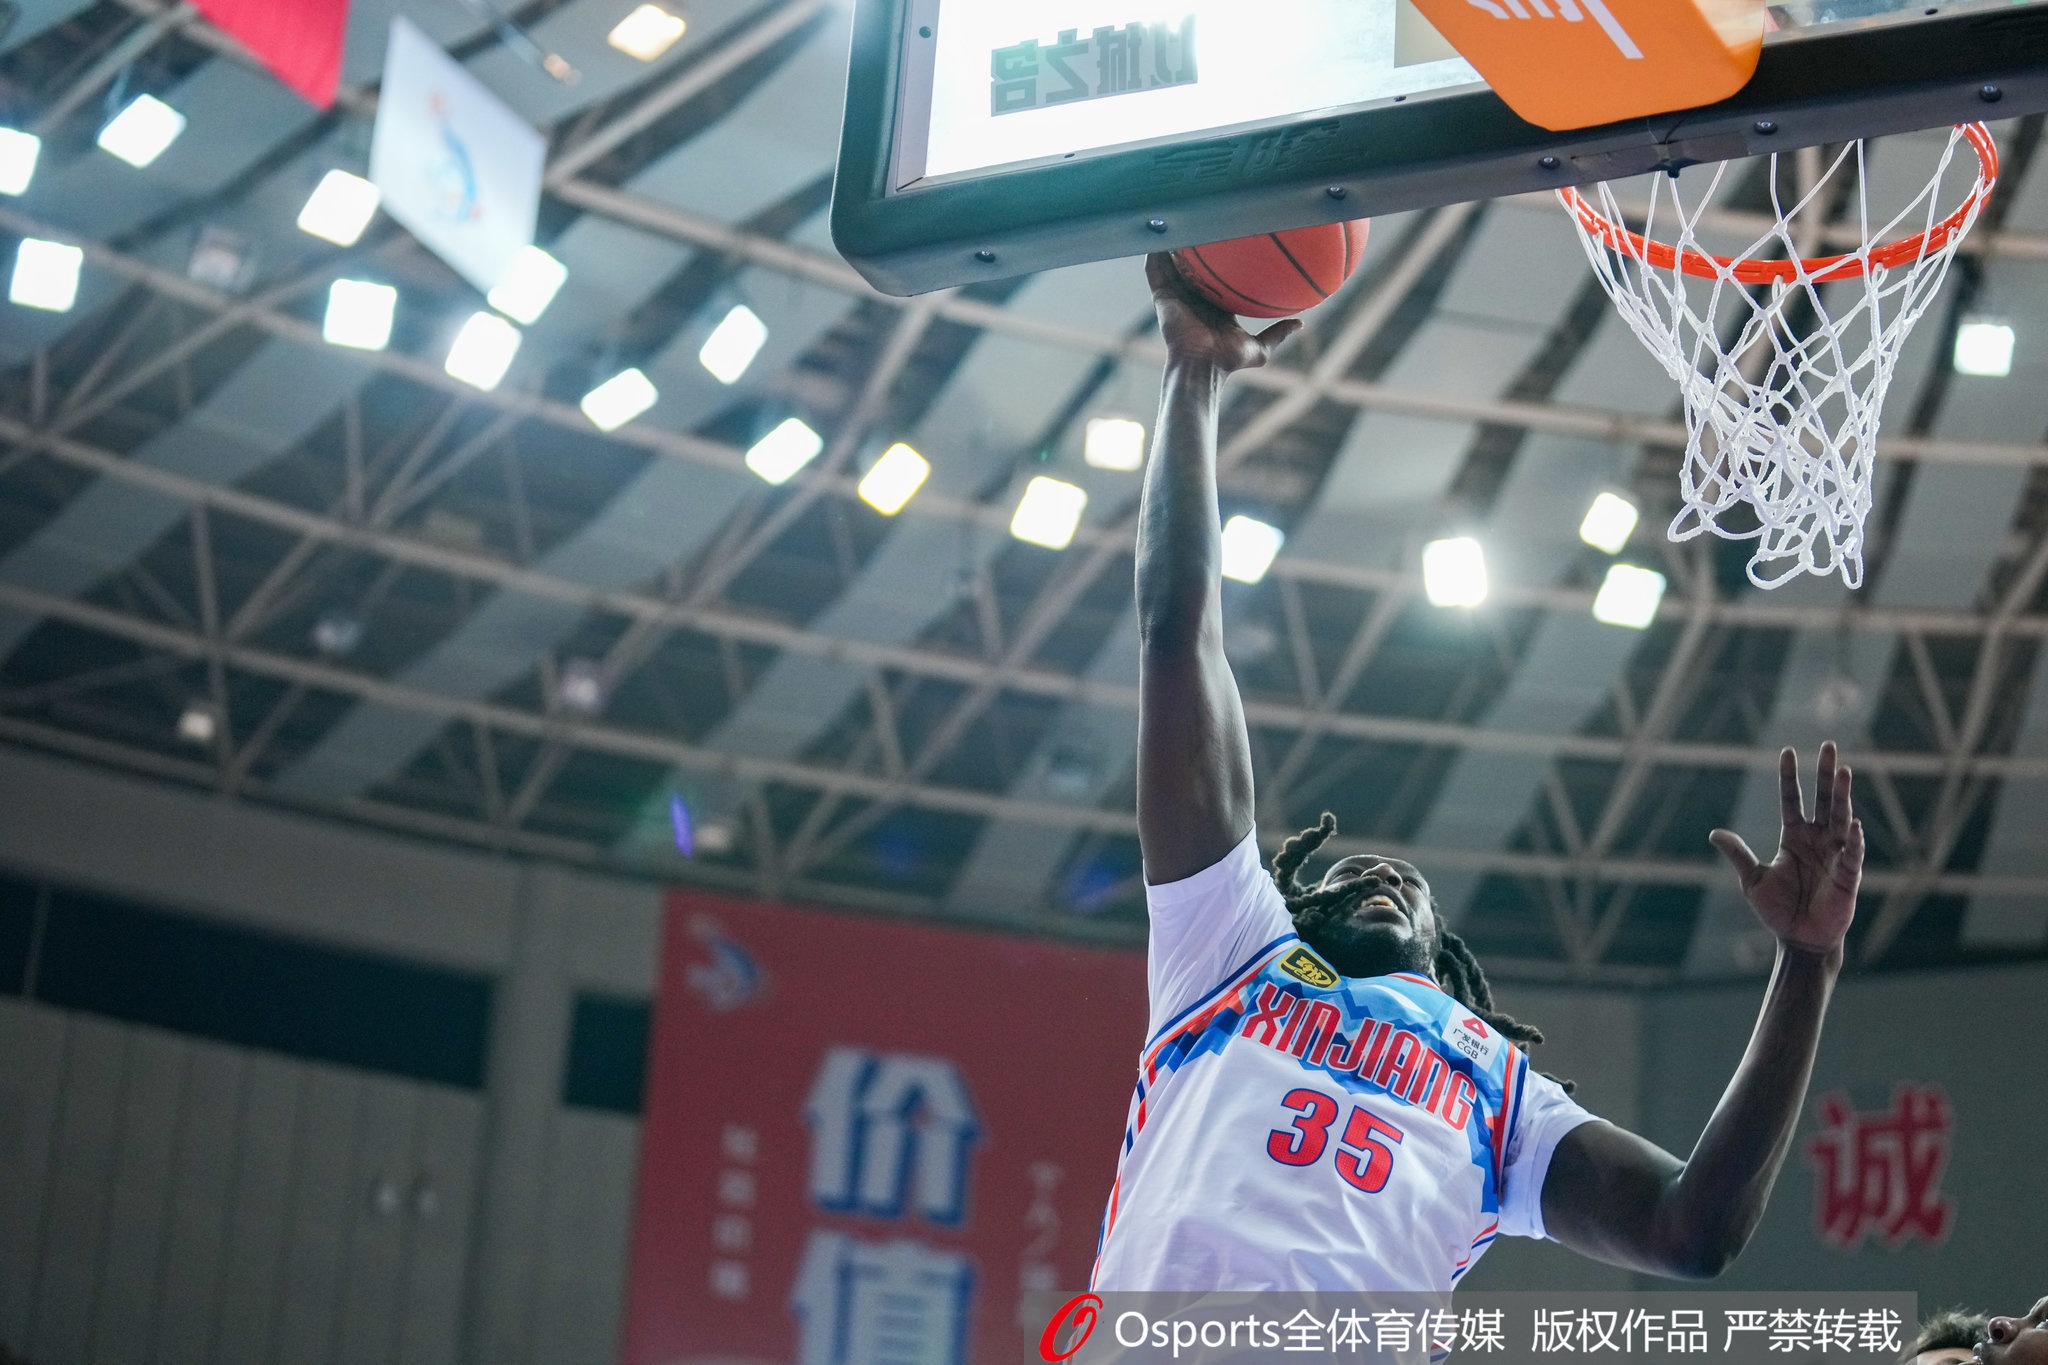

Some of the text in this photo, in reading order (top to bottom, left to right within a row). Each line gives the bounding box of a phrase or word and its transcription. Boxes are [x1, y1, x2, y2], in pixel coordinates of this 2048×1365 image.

[1240, 980, 1477, 1132] XINJIANG
[1453, 1028, 1490, 1056] 广发银行
[1456, 1040, 1479, 1060] CGB
[1266, 1087, 1404, 1194] 35
[1810, 1087, 1954, 1247] 诚
